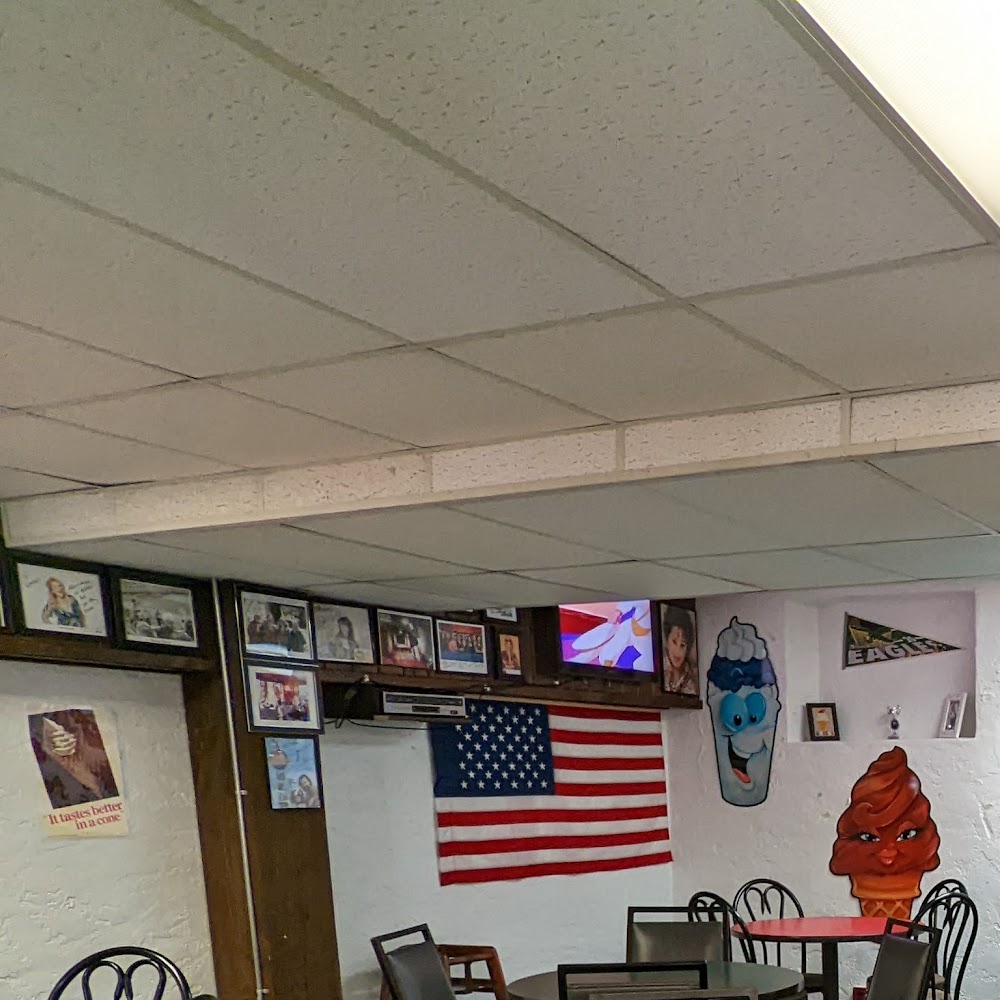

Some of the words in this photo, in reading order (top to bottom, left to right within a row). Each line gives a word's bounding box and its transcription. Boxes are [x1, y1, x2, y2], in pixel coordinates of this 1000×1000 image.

[48, 813, 59, 825] It
[59, 810, 91, 823] tastes
[91, 802, 123, 816] better
[75, 820, 88, 830] in
[89, 819, 97, 827] a
[97, 814, 120, 825] cone
